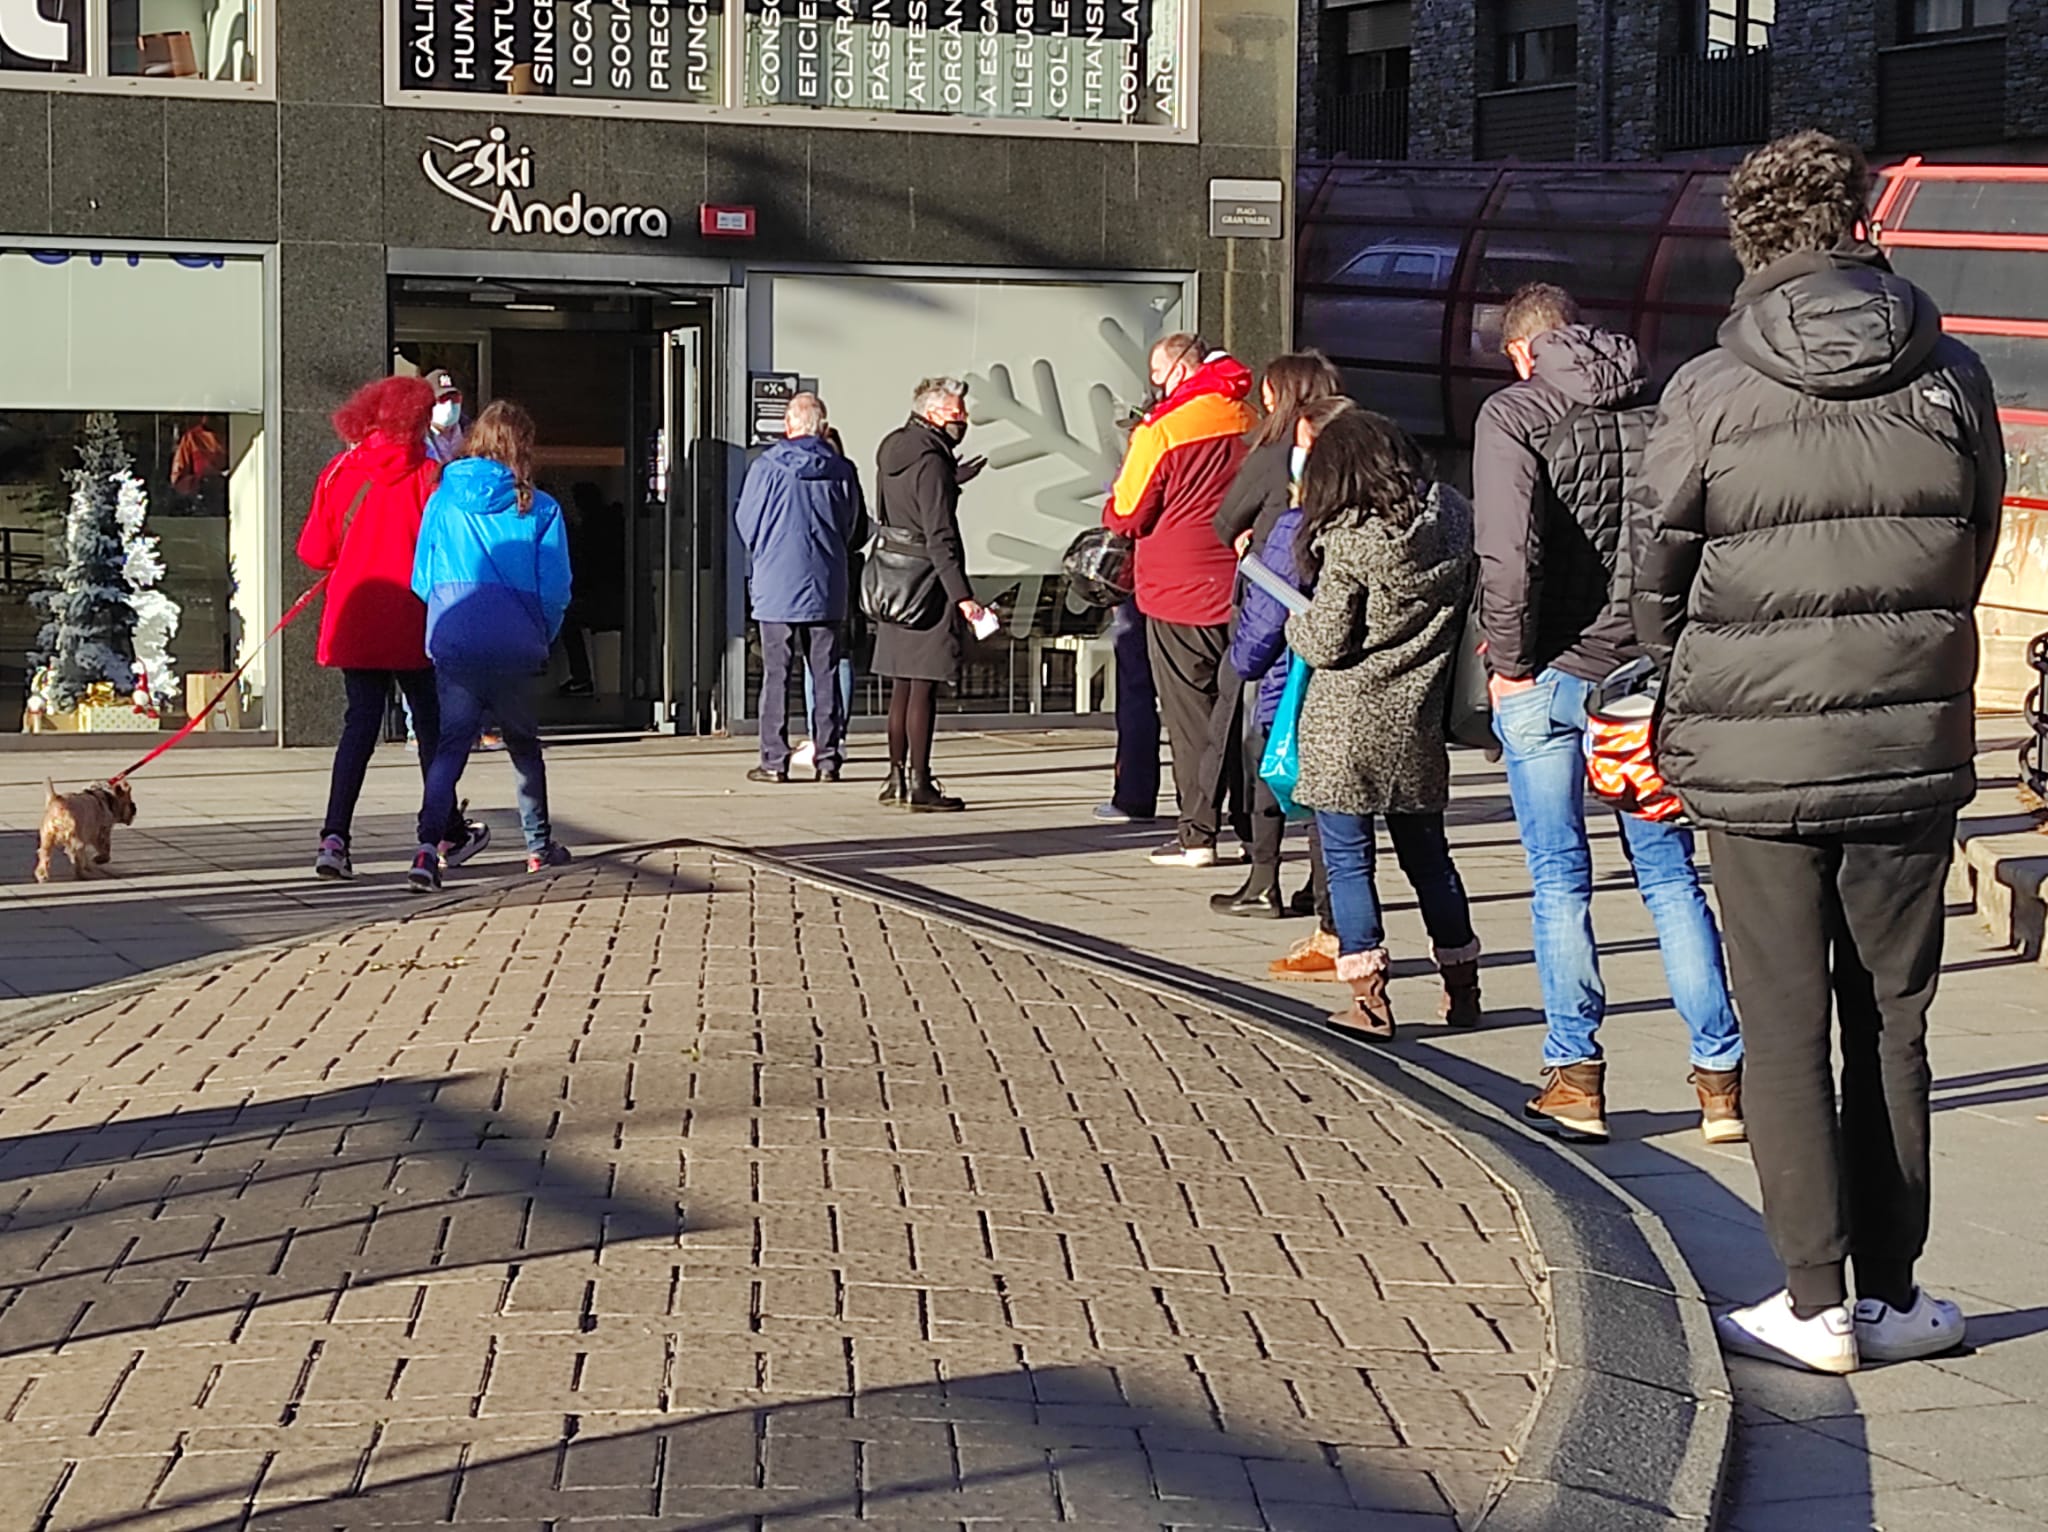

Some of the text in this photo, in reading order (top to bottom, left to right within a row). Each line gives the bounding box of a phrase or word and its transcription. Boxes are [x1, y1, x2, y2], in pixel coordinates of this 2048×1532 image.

[454, 0, 475, 79] HUM
[572, 0, 593, 86] LOCA
[834, 0, 854, 99] CLARA
[1086, 0, 1105, 110] TRANS
[980, 86, 998, 107] A
[490, 189, 668, 237] Andorra
